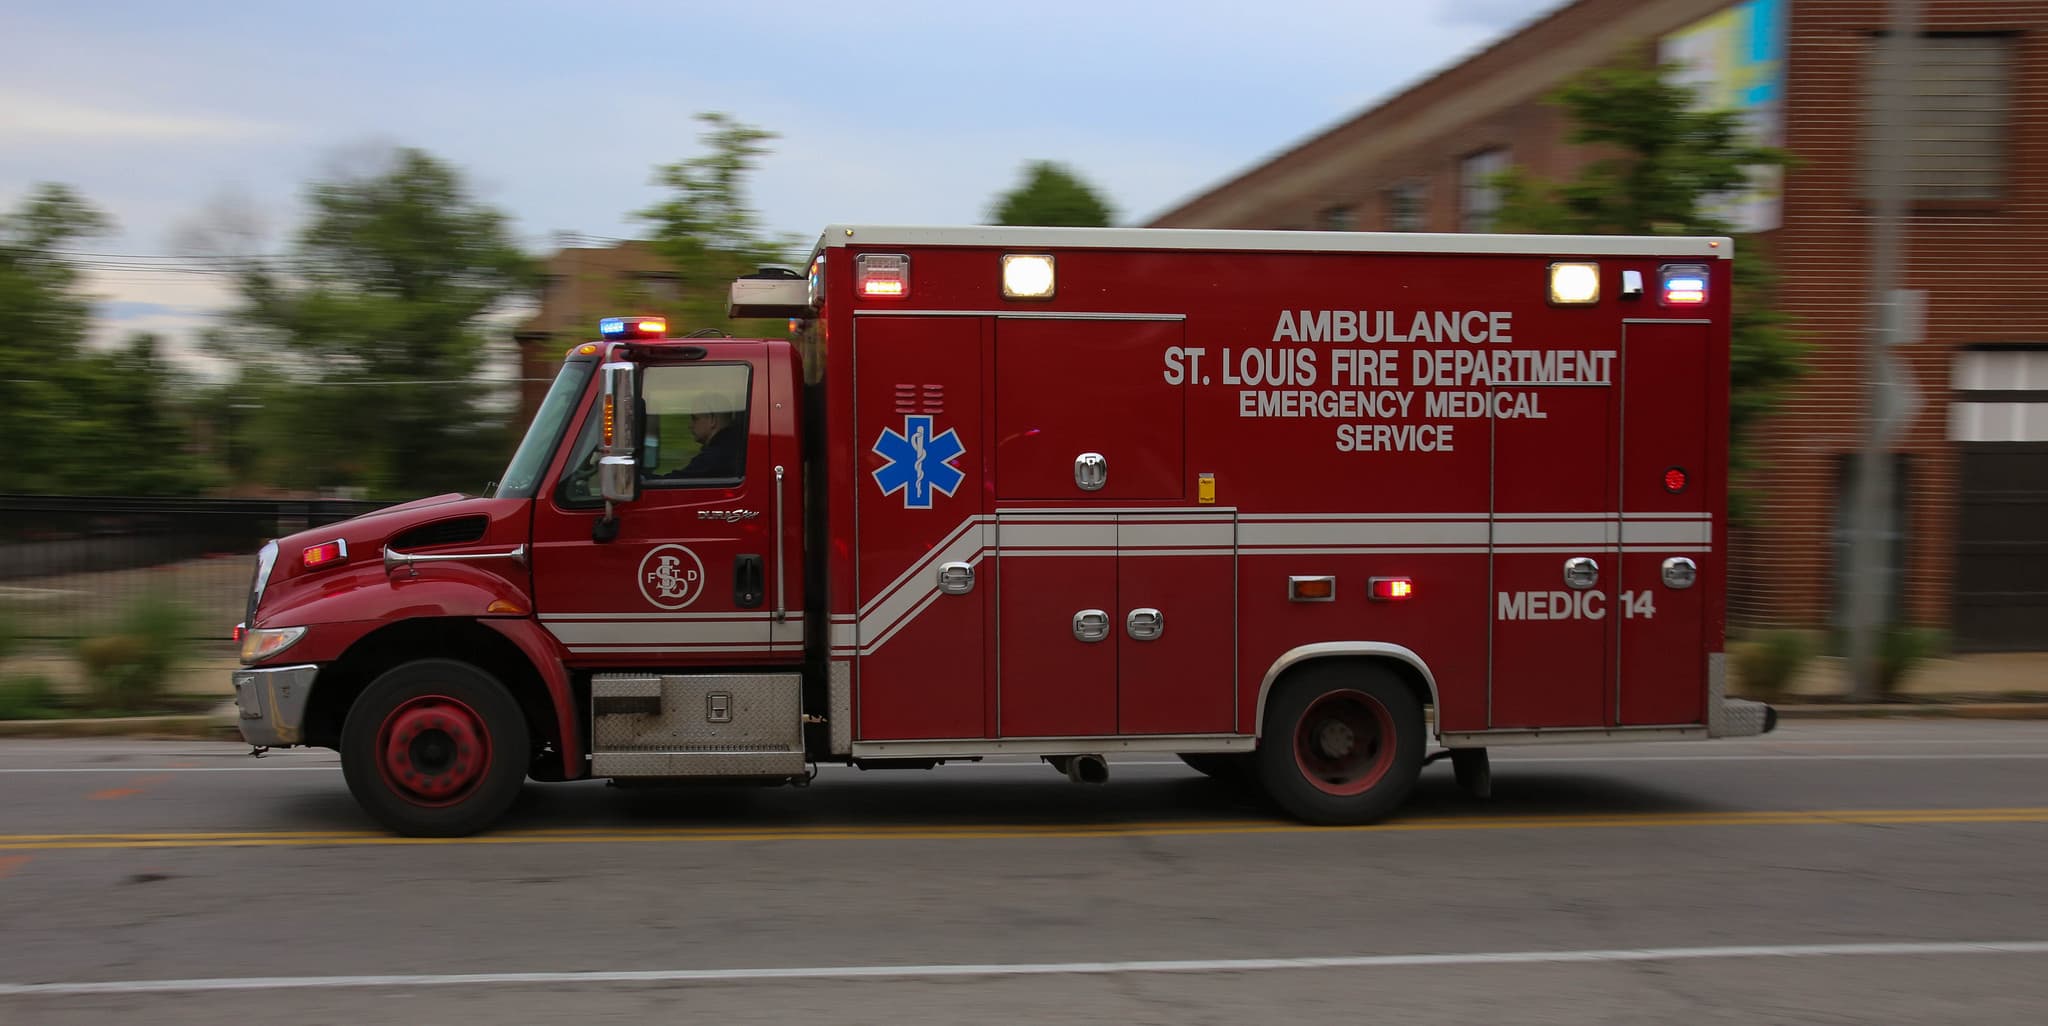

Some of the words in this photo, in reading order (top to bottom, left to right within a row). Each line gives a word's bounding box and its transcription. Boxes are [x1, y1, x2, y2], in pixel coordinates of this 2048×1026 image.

[1272, 309, 1513, 344] AMBULANCE
[1163, 345, 1210, 387] ST.
[1222, 347, 1317, 387] LOUIS
[1331, 348, 1399, 387] FIRE
[1412, 349, 1617, 387] DEPARTMENT
[1239, 389, 1415, 419] EMERGENCY
[1425, 390, 1547, 419] MEDICAL
[1335, 423, 1454, 452] SERVICE
[1498, 590, 1606, 621] MEDIC
[1621, 590, 1657, 619] 14
